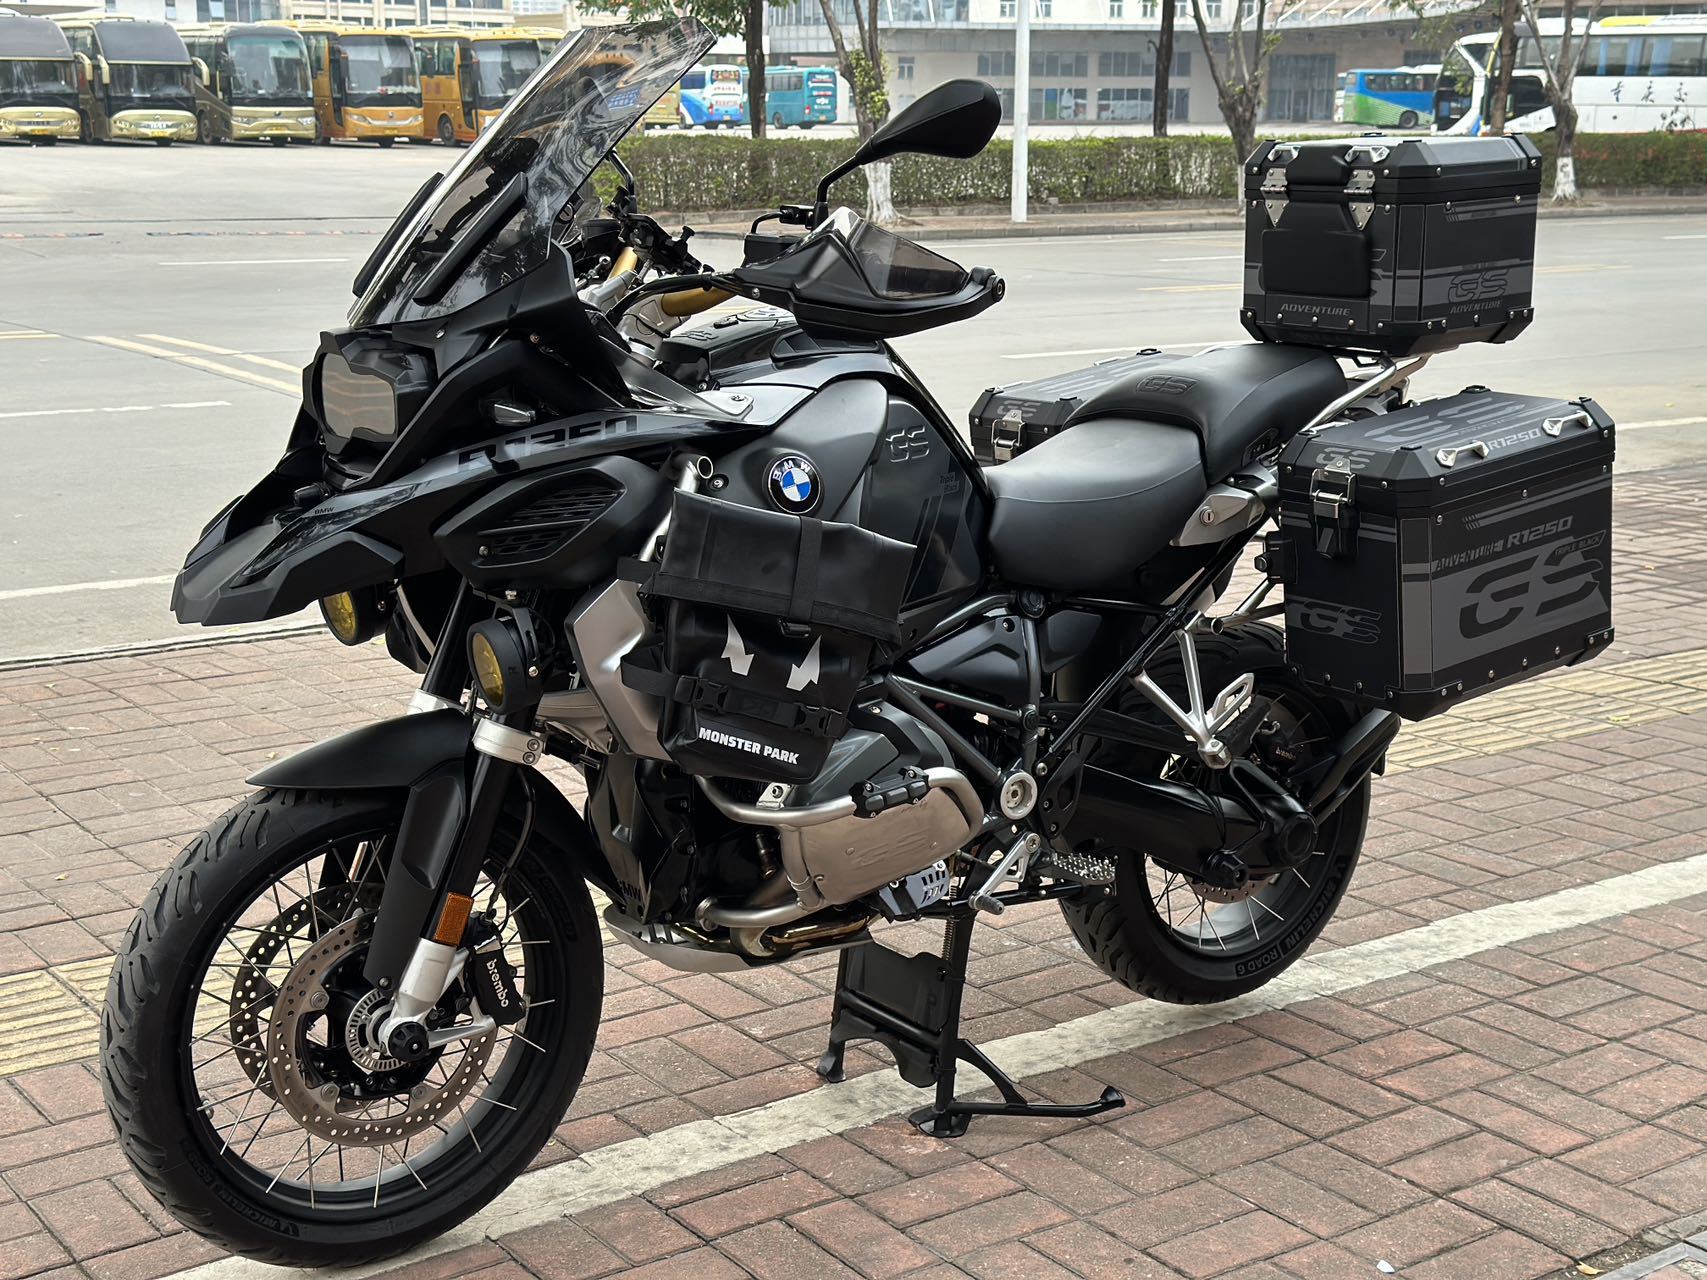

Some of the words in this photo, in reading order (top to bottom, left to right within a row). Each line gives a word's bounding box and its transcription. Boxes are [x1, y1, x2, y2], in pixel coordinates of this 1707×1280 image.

[1448, 268, 1510, 303] GS
[1280, 302, 1352, 317] ADVENTURE
[1137, 374, 1197, 395] GS
[1364, 396, 1526, 442] GS
[885, 425, 930, 463] GS
[1487, 428, 1541, 451] R1250
[772, 459, 812, 482] BMW
[314, 506, 336, 515] BMW
[1506, 514, 1575, 549] R1250
[1458, 530, 1607, 640] GS
[1300, 599, 1382, 645] GS
[698, 726, 762, 755] MONSTER
[763, 745, 800, 765] PARK
[1247, 947, 1279, 971] ROAD
[486, 958, 509, 1008] brembo
